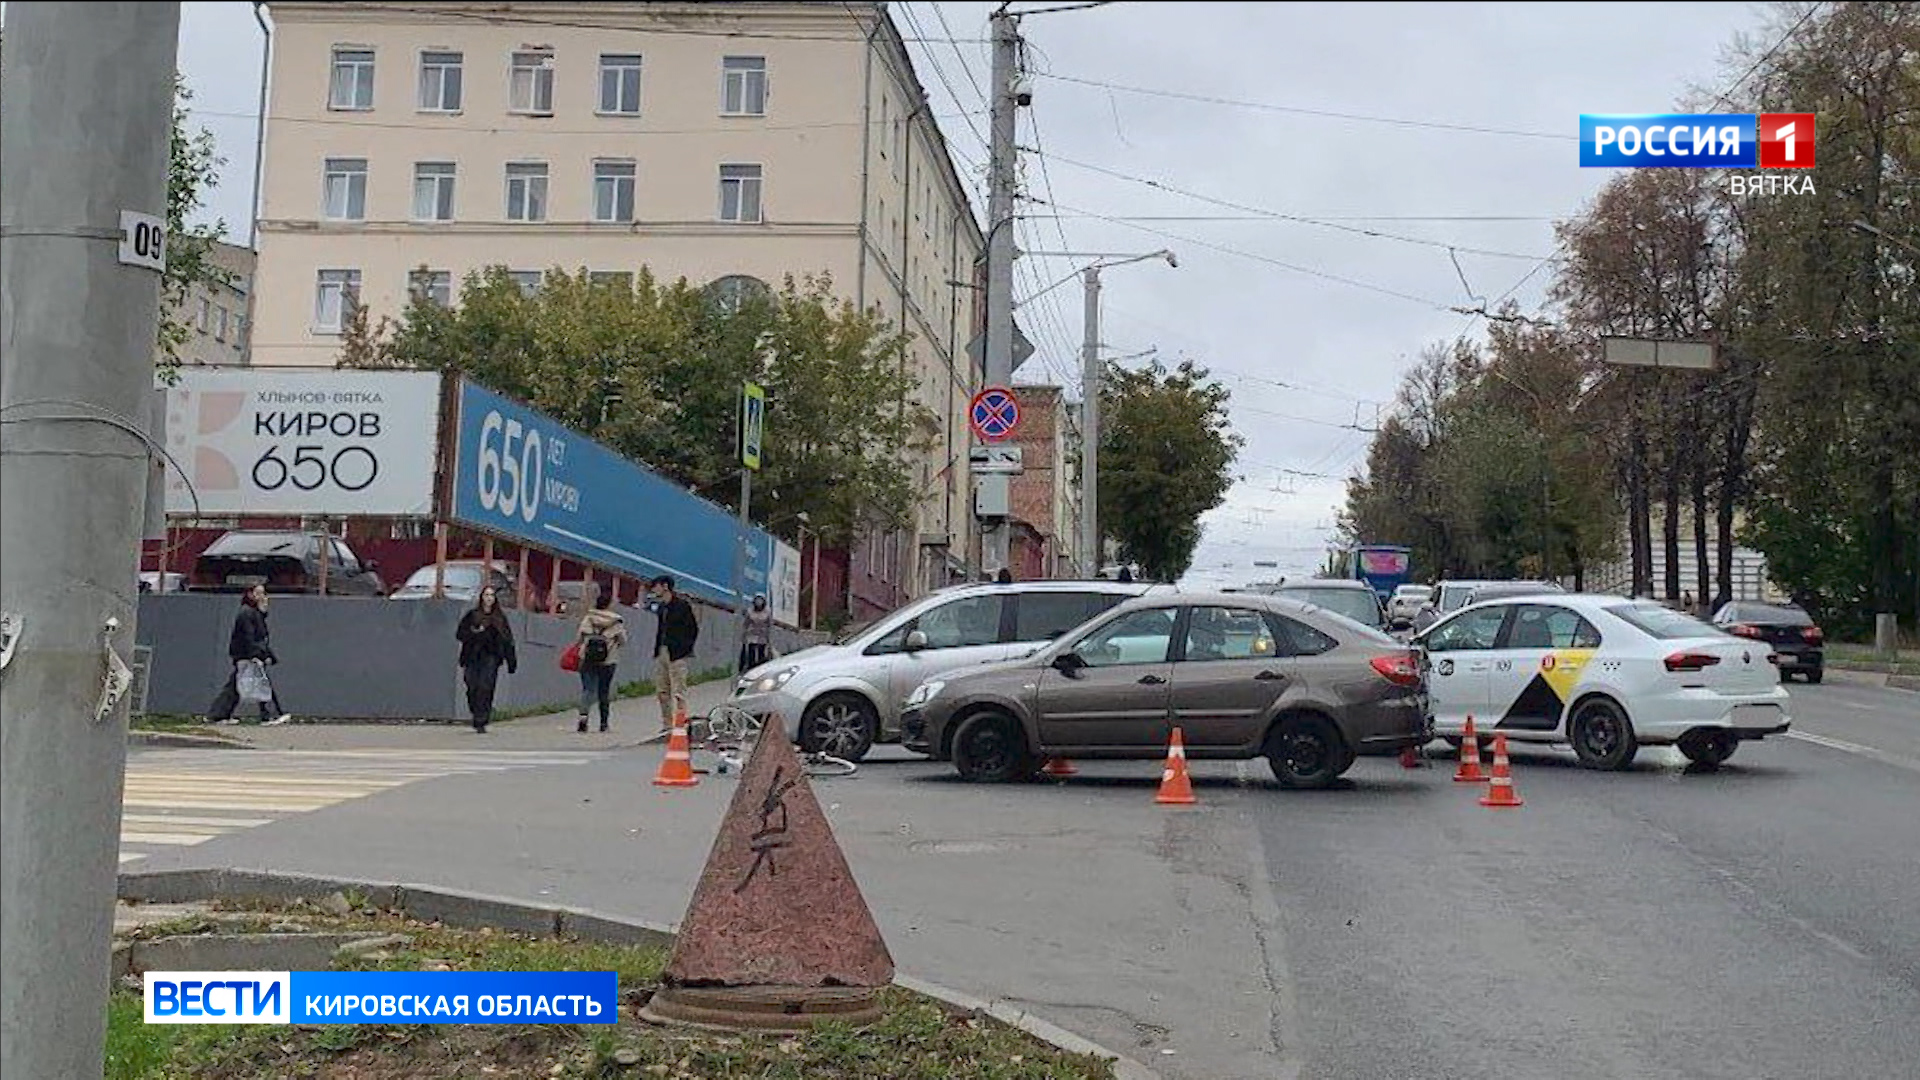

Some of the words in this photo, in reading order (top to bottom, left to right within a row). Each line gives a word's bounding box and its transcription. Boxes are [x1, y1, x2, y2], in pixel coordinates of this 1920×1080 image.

[135, 221, 161, 260] 09
[254, 411, 381, 436] КИРОВ
[252, 445, 378, 491] 650
[478, 410, 542, 523] 650
